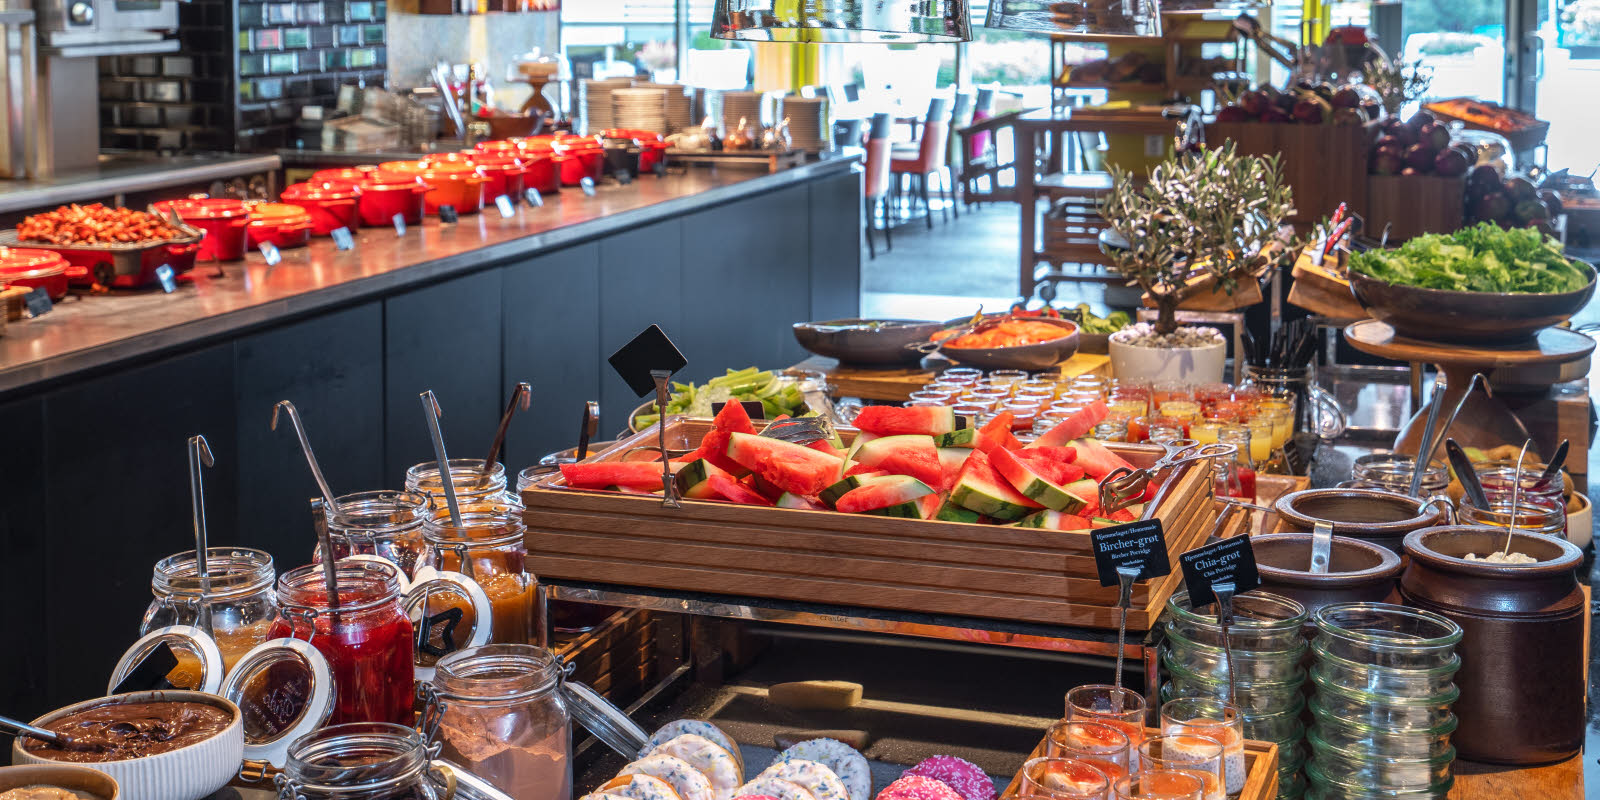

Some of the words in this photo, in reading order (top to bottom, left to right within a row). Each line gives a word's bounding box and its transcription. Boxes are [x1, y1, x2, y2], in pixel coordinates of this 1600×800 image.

[1099, 534, 1159, 553] Bircher-grøt
[1111, 552, 1129, 560] Bircher
[1129, 547, 1151, 556] Porridge
[1194, 550, 1241, 571] Chia-grøt
[1203, 570, 1216, 578] Chia
[1215, 563, 1237, 575] Porridge
